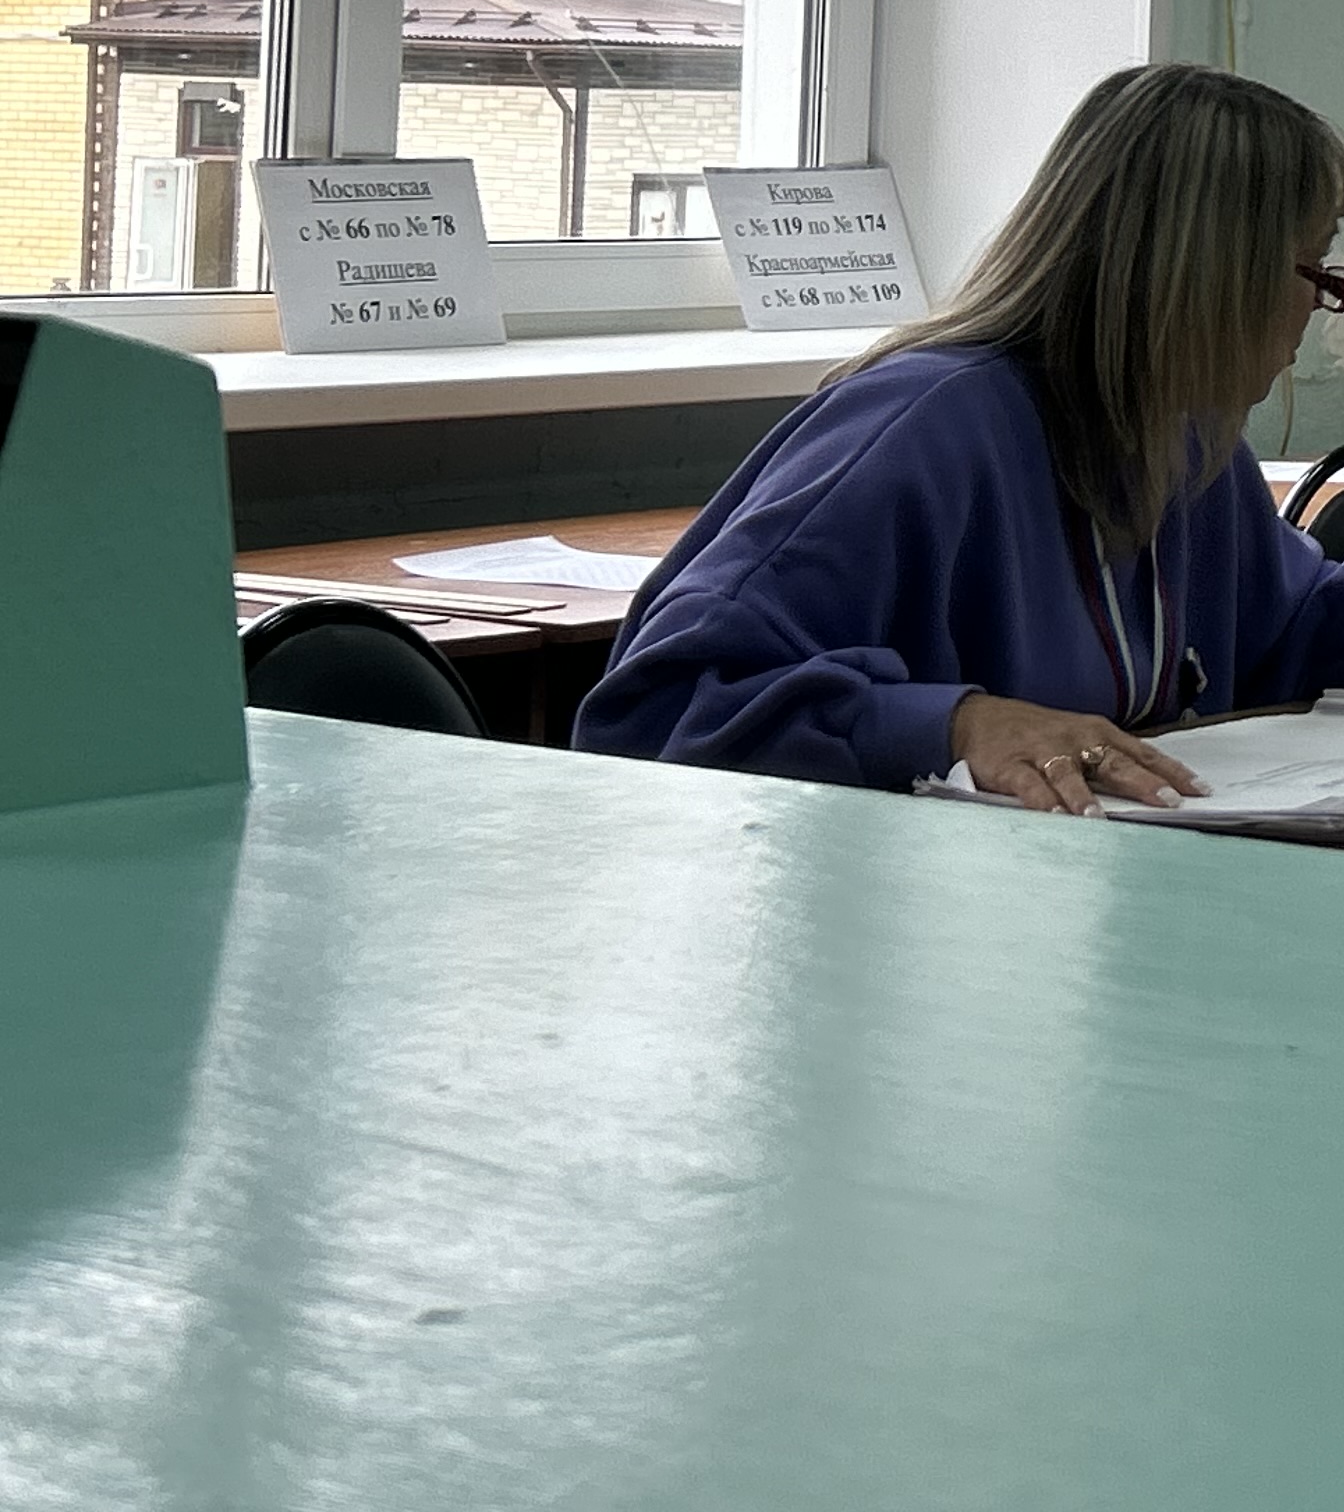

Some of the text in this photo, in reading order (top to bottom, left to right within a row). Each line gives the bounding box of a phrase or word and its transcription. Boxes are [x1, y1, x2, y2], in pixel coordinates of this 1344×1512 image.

[308, 178, 432, 199] Московская
[767, 183, 834, 202] Кирова
[316, 219, 340, 240] №
[345, 218, 370, 238] 66
[375, 222, 400, 238] по
[405, 216, 428, 237] №
[431, 215, 456, 236] 78
[751, 218, 769, 236] №
[772, 217, 802, 236] 119
[808, 220, 830, 235] по
[832, 215, 852, 234] №
[856, 214, 887, 232] 174
[745, 251, 896, 274] Красноармейская
[775, 289, 796, 307] №
[799, 288, 820, 306] 68
[823, 290, 845, 305] по
[849, 286, 868, 303] №
[871, 283, 901, 302] 109
[330, 297, 456, 325] № 67 и № 69
